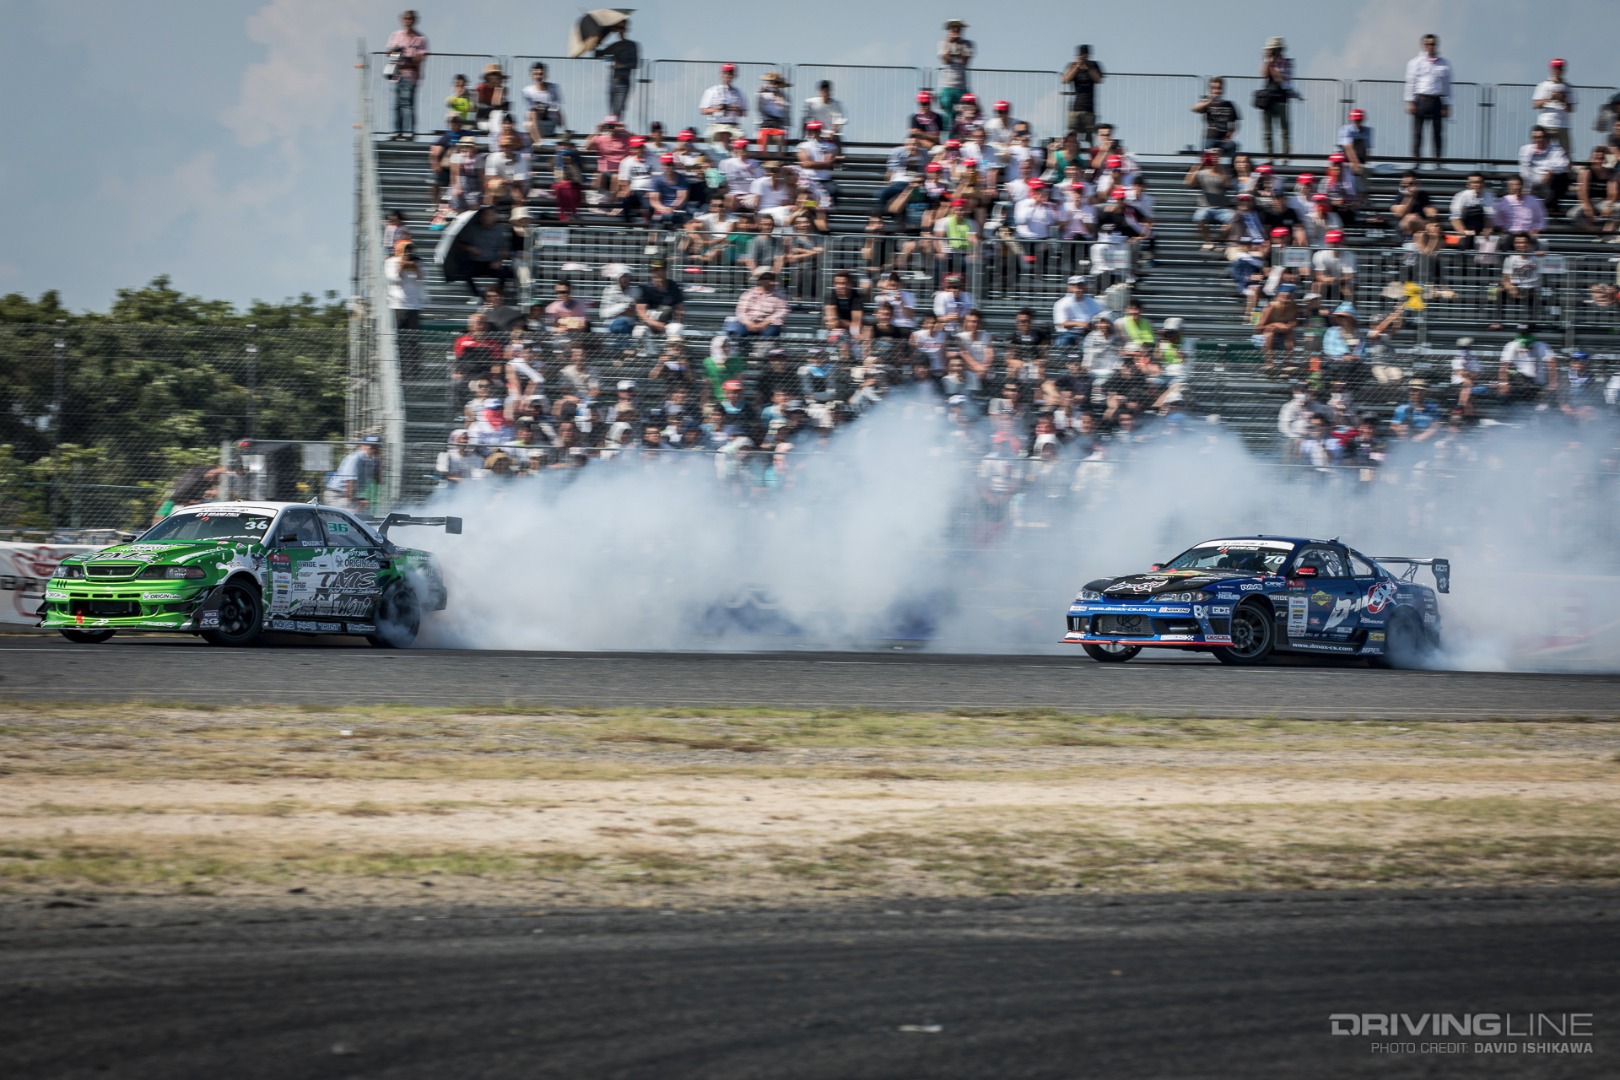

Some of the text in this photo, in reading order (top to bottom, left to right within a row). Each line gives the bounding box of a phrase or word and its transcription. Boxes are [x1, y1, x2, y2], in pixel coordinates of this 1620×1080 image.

[245, 521, 268, 530] 36
[328, 522, 349, 532] 36
[344, 559, 366, 568] ORIGIN
[1264, 555, 1287, 565] 70
[317, 571, 377, 588] TMS
[1212, 606, 1230, 614] GCG
[1292, 643, 1353, 651] www.dmax-cs.com
